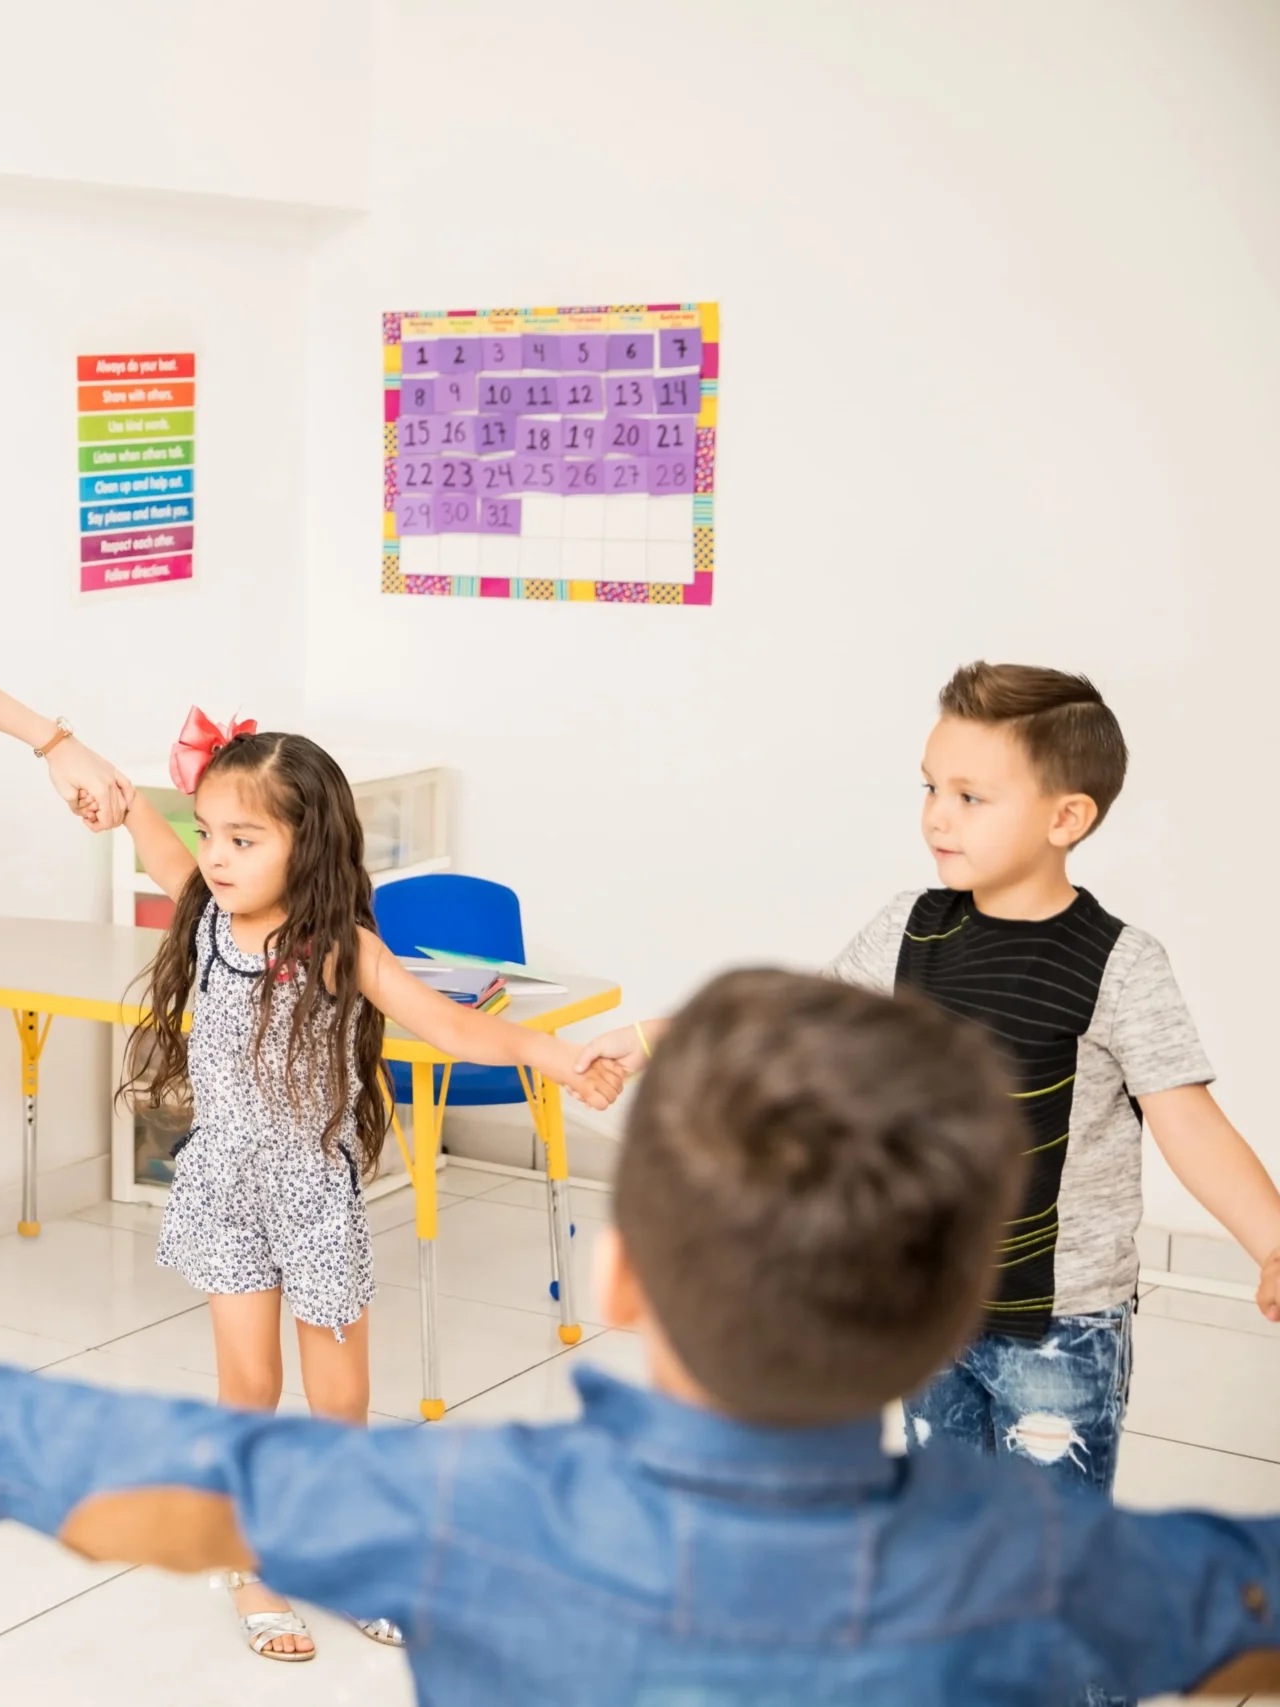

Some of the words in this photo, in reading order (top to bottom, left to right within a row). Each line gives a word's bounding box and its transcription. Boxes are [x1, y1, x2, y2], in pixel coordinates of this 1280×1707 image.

[416, 346, 428, 364] 1
[454, 346, 466, 364] 2
[493, 343, 505, 363] 3
[533, 343, 545, 362] 4
[578, 343, 589, 363] 5
[626, 343, 636, 358] 6
[673, 339, 687, 358] 7
[96, 360, 126, 375] Always
[127, 359, 138, 372] do
[140, 361, 157, 374] your
[158, 358, 178, 372] best.
[102, 389, 126, 403] Share
[128, 388, 145, 402] with
[147, 387, 173, 401] others.
[415, 389, 425, 407] 8
[450, 383, 461, 402] 9
[485, 386, 511, 406] 10
[527, 387, 551, 405] 11
[567, 386, 592, 405] 12
[616, 383, 642, 406] 13
[660, 380, 687, 405] 14
[405, 421, 430, 447] 15
[441, 421, 466, 444] 16
[482, 422, 506, 446] 17
[526, 429, 550, 450] 18
[565, 425, 594, 449] 19
[613, 425, 639, 446] 20
[657, 424, 684, 447] 21
[93, 450, 117, 464] Listen
[118, 448, 140, 461] when
[142, 446, 167, 460] others
[168, 445, 185, 458] talk.
[94, 480, 118, 494] Clean
[120, 481, 131, 495] up
[132, 477, 149, 491] and
[149, 476, 167, 492] help
[169, 476, 184, 488] out.
[405, 463, 433, 487] 22
[443, 463, 473, 487] 23
[484, 463, 514, 489] 24
[523, 463, 554, 486] 25
[568, 463, 597, 488] 26
[614, 465, 640, 486] 27
[657, 463, 687, 486] 28
[87, 512, 103, 527] Say
[104, 509, 131, 526] please
[132, 506, 149, 520] and
[150, 504, 172, 519] thank
[173, 506, 189, 520] you.
[402, 503, 431, 528] 29
[442, 502, 469, 524] 30
[487, 506, 513, 527] 31
[105, 568, 130, 582] Follow
